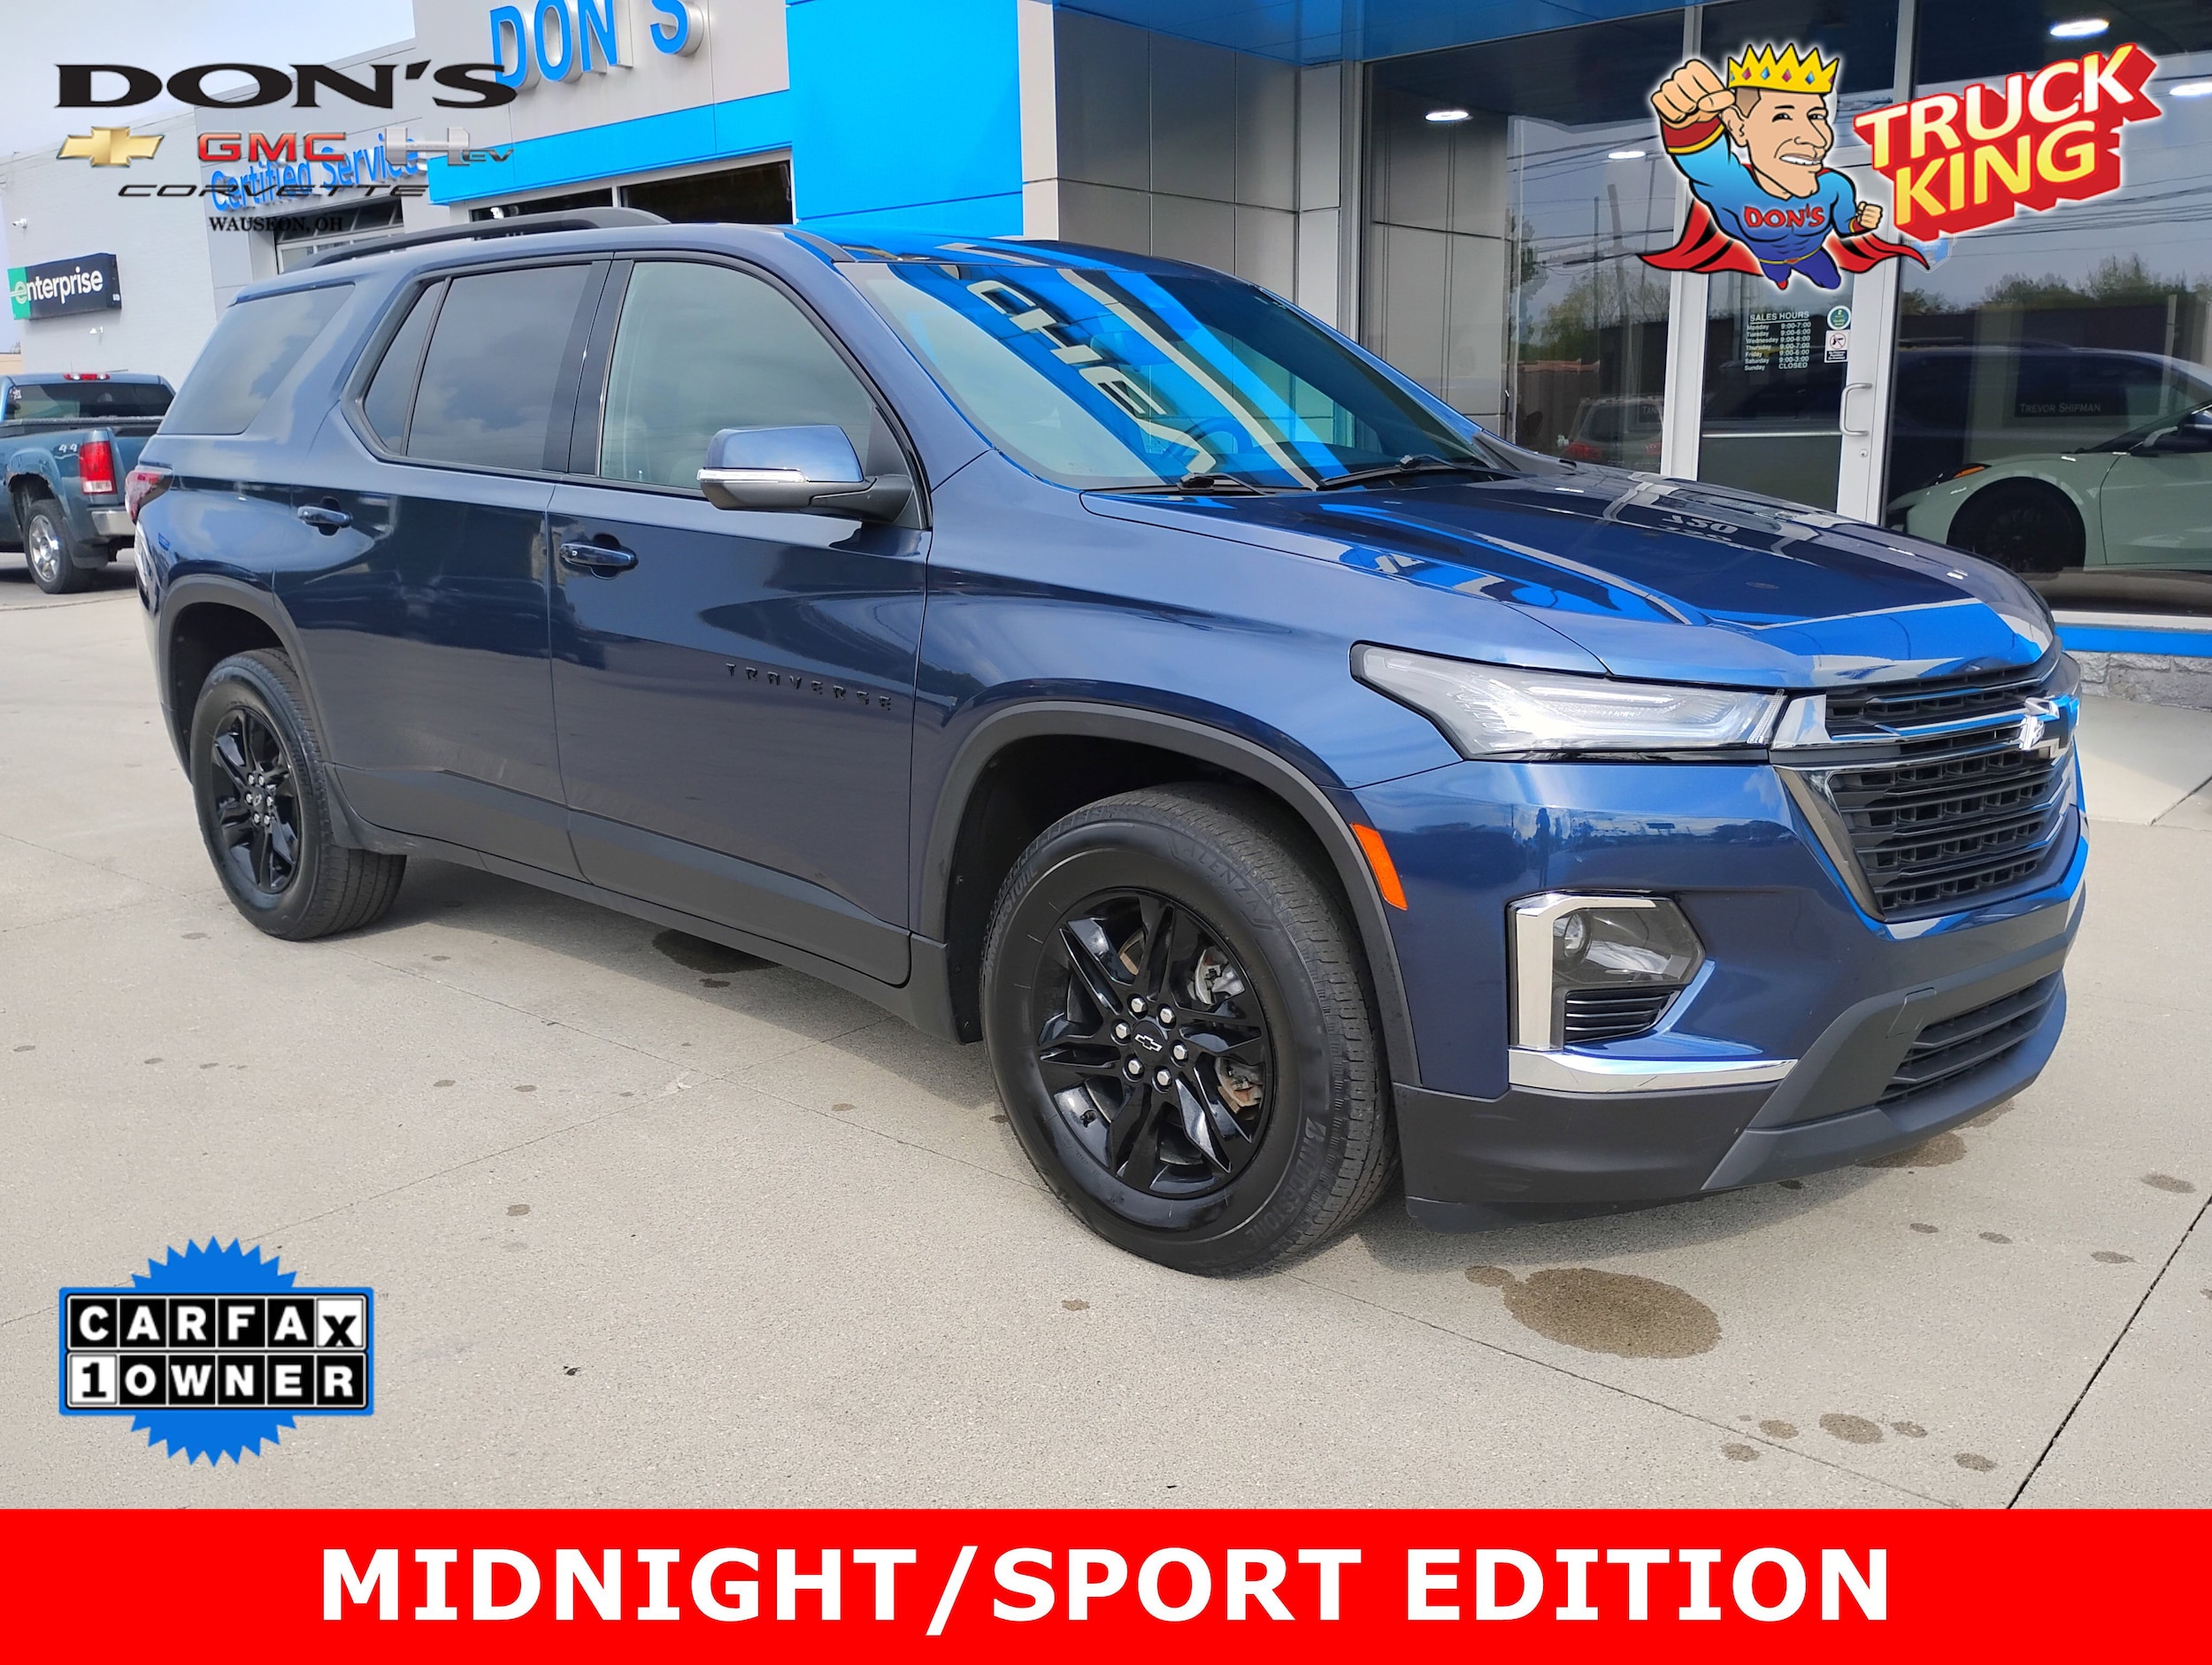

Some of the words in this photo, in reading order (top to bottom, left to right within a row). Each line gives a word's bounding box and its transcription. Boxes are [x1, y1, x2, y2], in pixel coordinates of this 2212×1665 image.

[489, 0, 688, 89] DONS
[211, 159, 312, 212] Certified
[11, 266, 104, 304] enterprise
[1749, 312, 1778, 322] SALES
[1779, 311, 1809, 320] HOURS
[2019, 403, 2055, 413] TREVOR
[2058, 402, 2101, 413] SHIPMAN
[58, 443, 78, 453] 44
